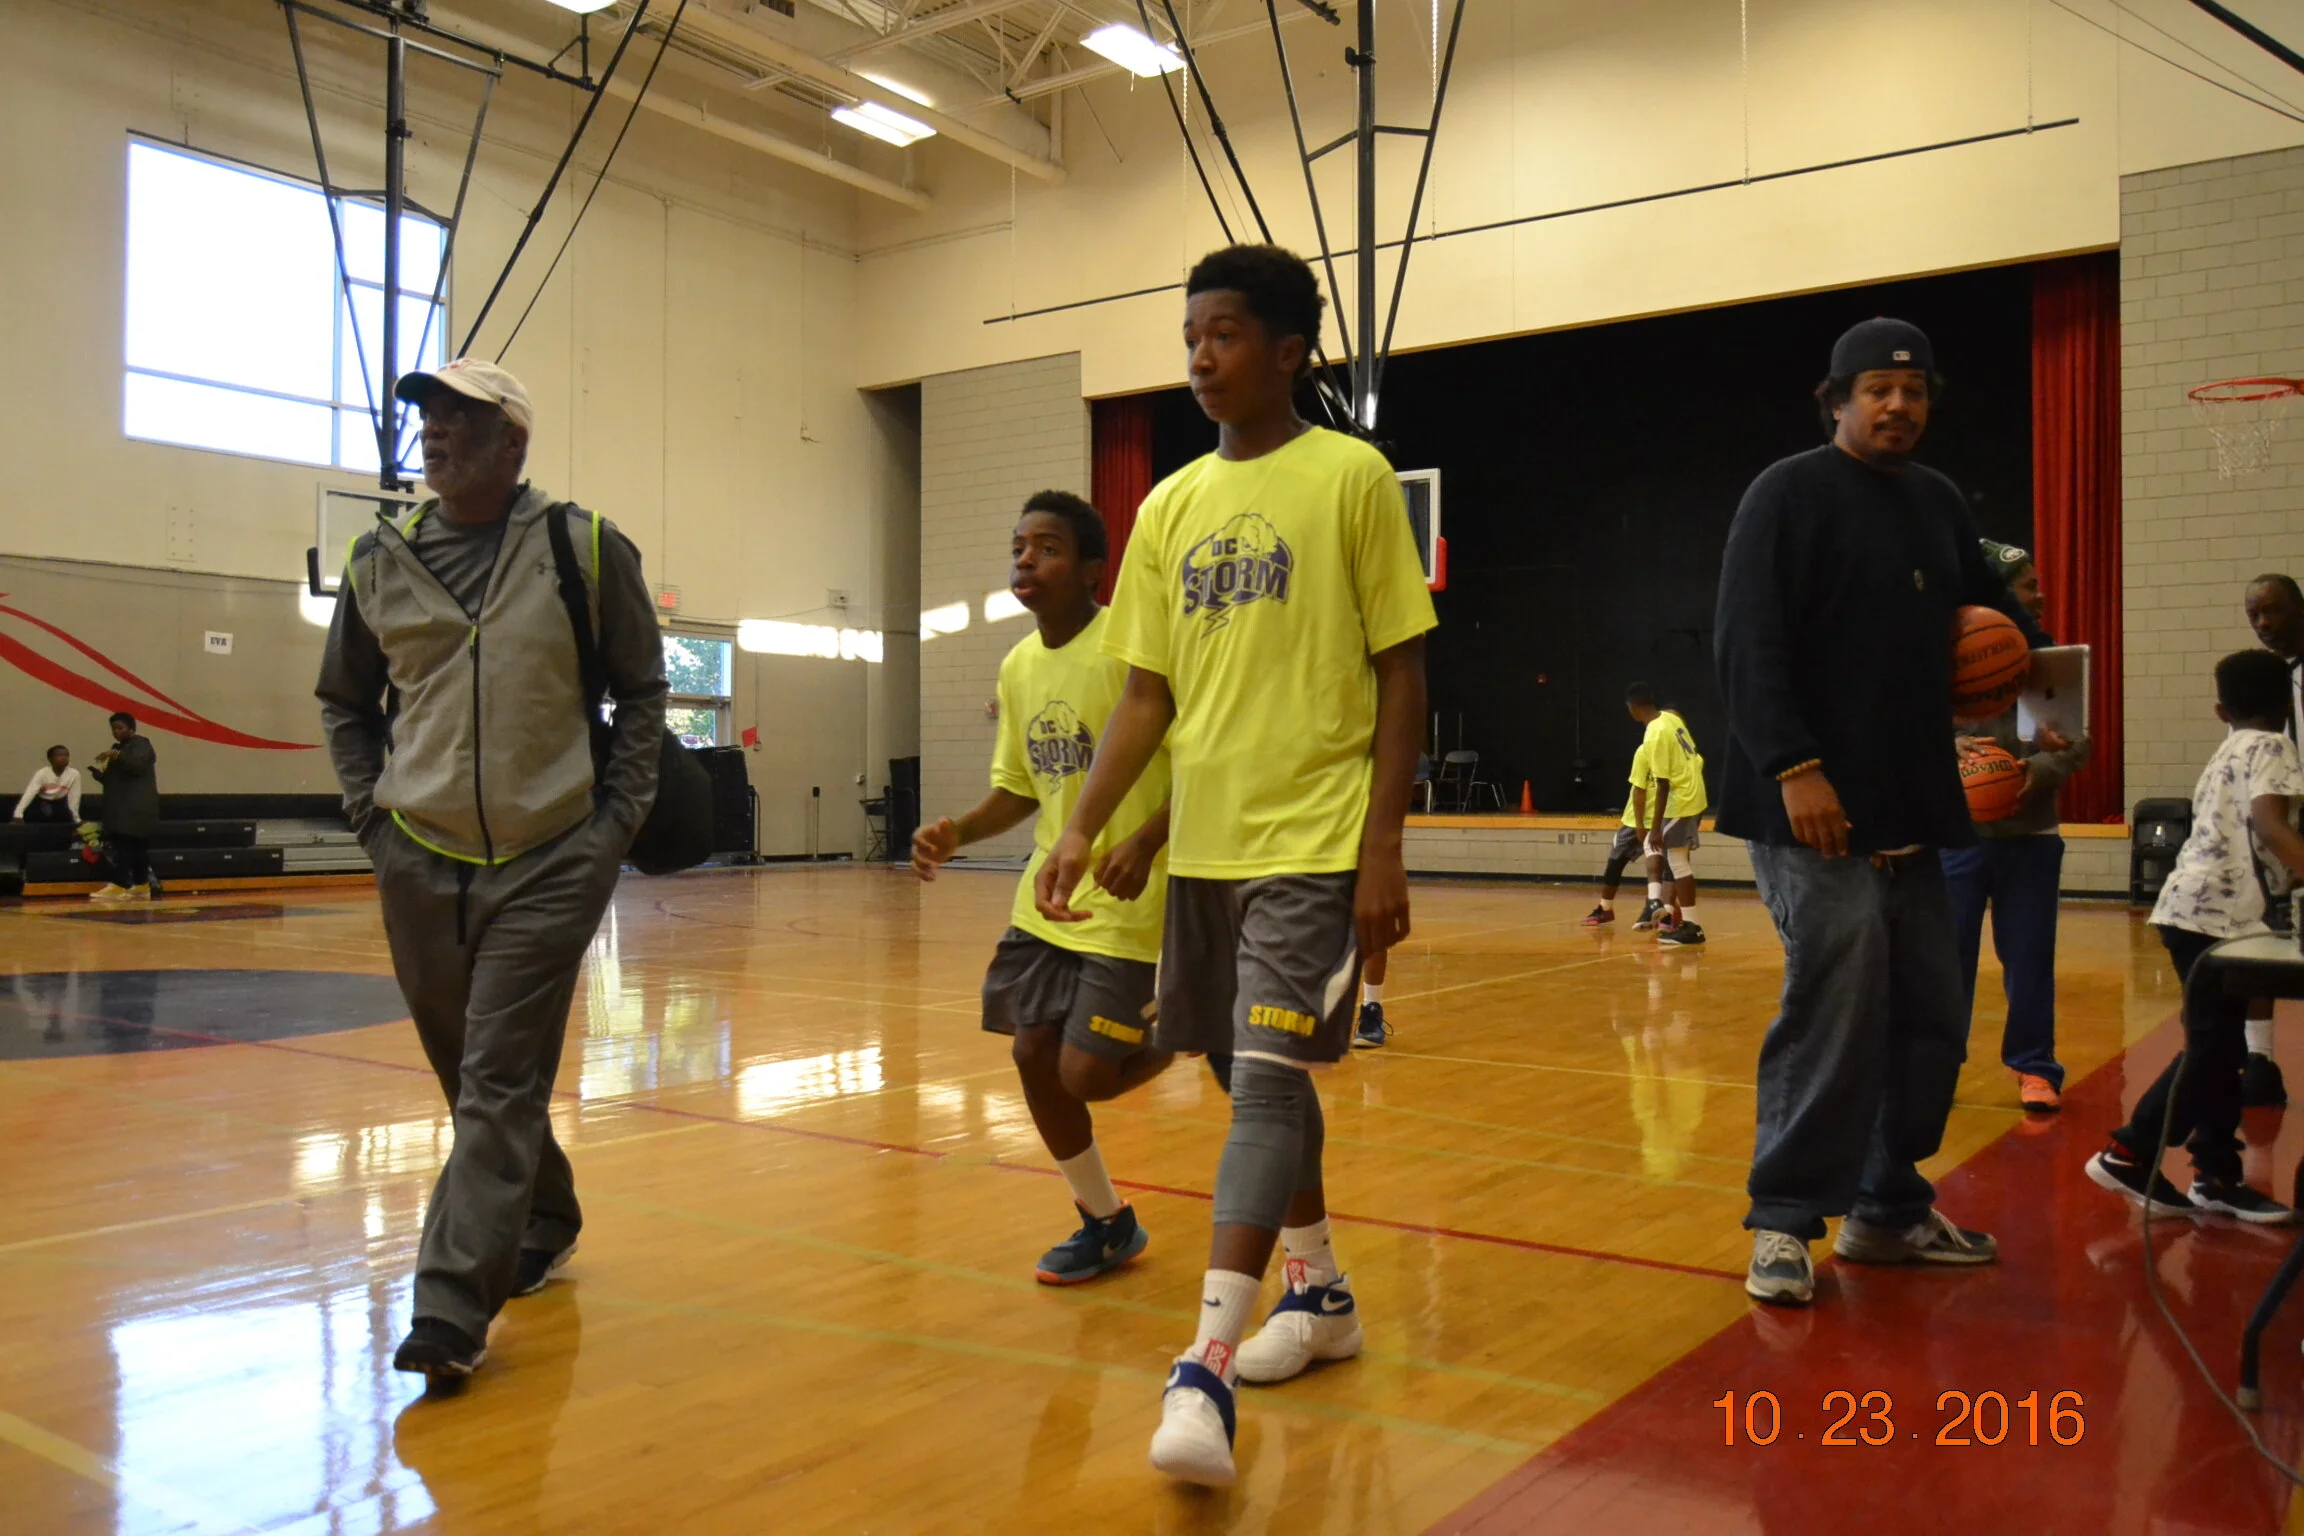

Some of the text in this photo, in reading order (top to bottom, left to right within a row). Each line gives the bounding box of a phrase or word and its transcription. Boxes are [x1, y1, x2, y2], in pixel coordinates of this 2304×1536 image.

[1211, 538, 1238, 557] DC
[1183, 556, 1289, 616] STORM
[1031, 737, 1093, 777] STORM
[1248, 1005, 1317, 1037] STORM
